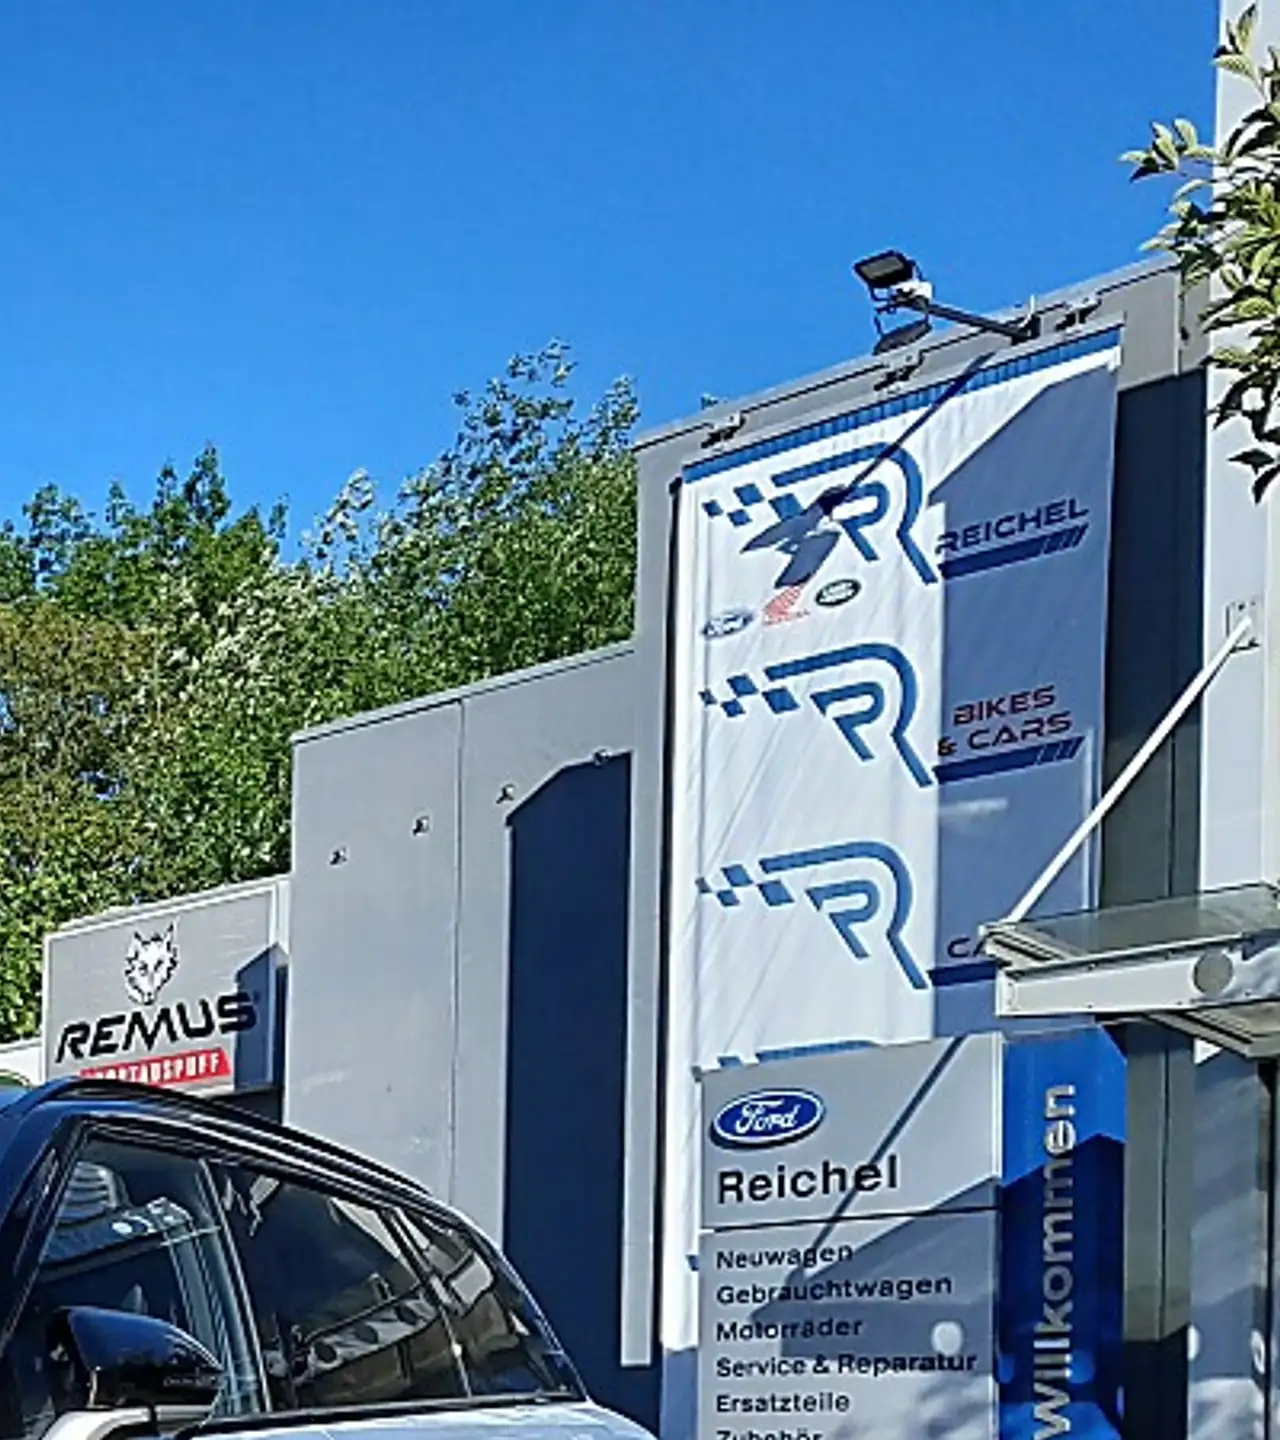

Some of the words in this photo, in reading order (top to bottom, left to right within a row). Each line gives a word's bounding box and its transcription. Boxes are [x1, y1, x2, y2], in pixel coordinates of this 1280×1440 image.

[935, 498, 1089, 554] REICHEL
[953, 684, 1056, 727] BIKES
[937, 735, 958, 757] &
[967, 709, 1073, 750] CARS
[55, 991, 258, 1063] REMUS
[85, 1052, 220, 1084] ORTAUSPUFF
[735, 1098, 801, 1134] Ford
[717, 1153, 898, 1205] Reichel
[716, 1244, 854, 1269] Neuwagen
[716, 1275, 953, 1305] Gebrauchtwagen
[716, 1356, 808, 1378] Service
[812, 1354, 831, 1375] &
[837, 1352, 978, 1377] Reparatur
[716, 1391, 851, 1414] Ersatzteile
